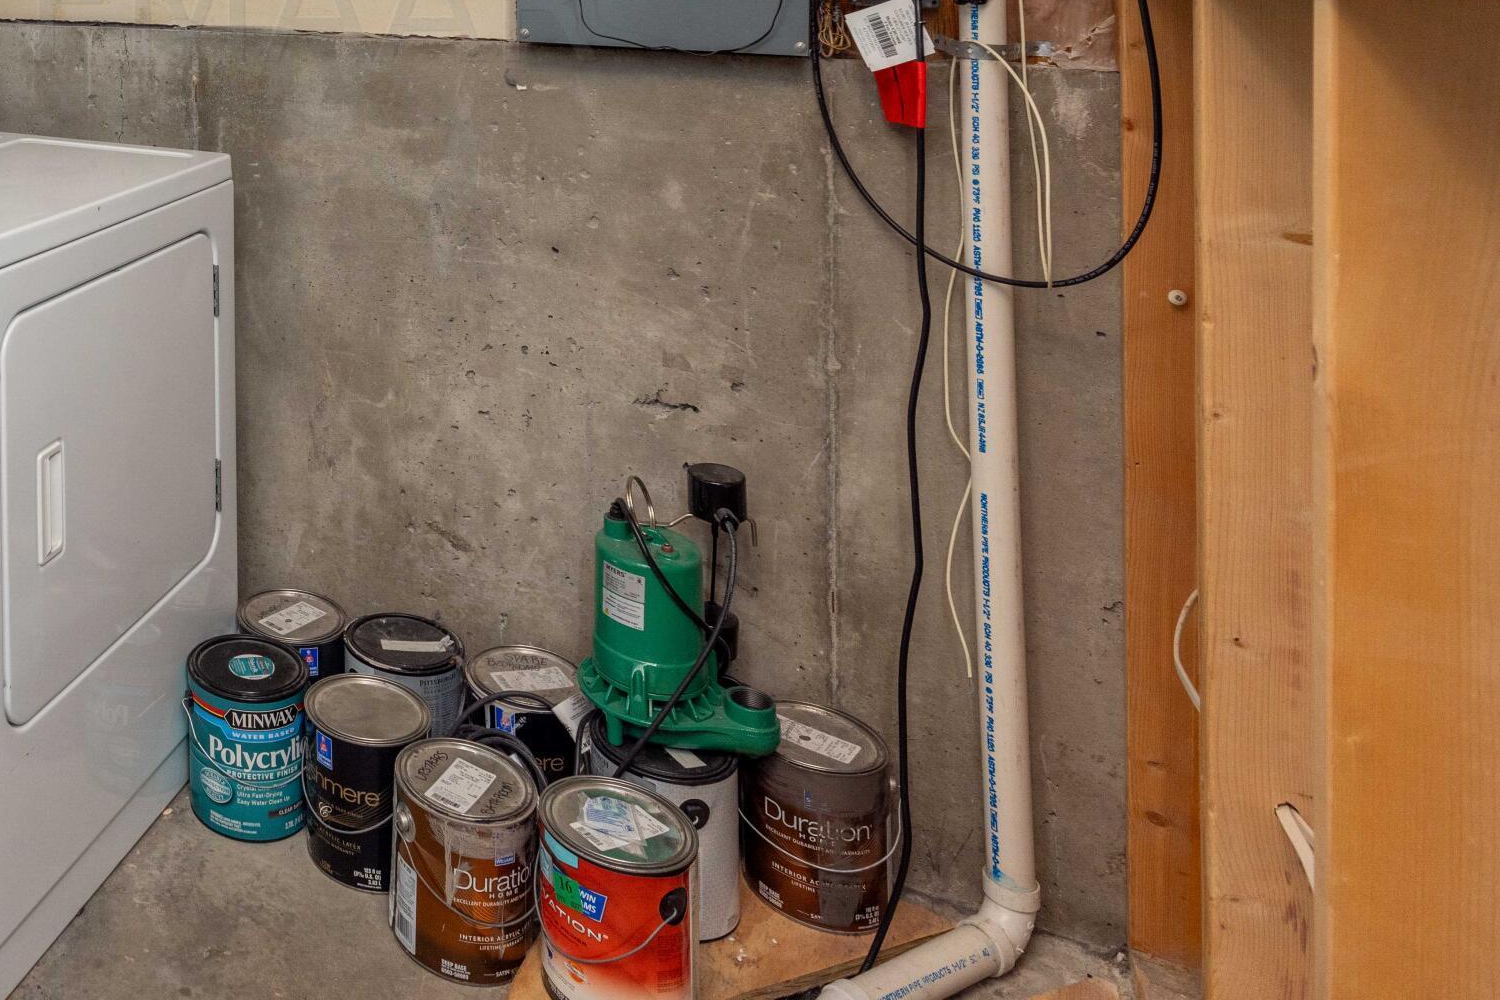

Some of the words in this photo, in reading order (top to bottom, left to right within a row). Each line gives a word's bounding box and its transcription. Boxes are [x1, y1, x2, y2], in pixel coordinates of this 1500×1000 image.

[972, 134, 980, 144] 40
[972, 164, 980, 175] PSI
[973, 224, 981, 242] 1120
[980, 493, 989, 535] NORTHERN
[981, 536, 989, 554] PIPE
[604, 563, 626, 578] MYERS
[981, 555, 990, 597] PRODUCTS
[984, 641, 992, 652] 40
[231, 706, 296, 730] MINWAX
[231, 730, 265, 741] WATER
[268, 727, 296, 739] BASED
[226, 768, 275, 781] PROTECTIVE
[276, 765, 299, 778] FINISH
[236, 790, 251, 798] Ultra
[251, 790, 283, 799] Fast-Drying
[236, 797, 250, 806] Easy
[251, 798, 268, 806] Water
[268, 797, 283, 805] Clean
[764, 795, 871, 843] Duration
[453, 862, 532, 894] Duratio
[771, 860, 808, 882] INTERIOR
[559, 875, 573, 894] 16
[489, 887, 519, 900] HOME
[453, 896, 482, 907] EXCELLENT
[459, 933, 495, 943] INTERIOR
[496, 928, 521, 942] ACRYLIC
